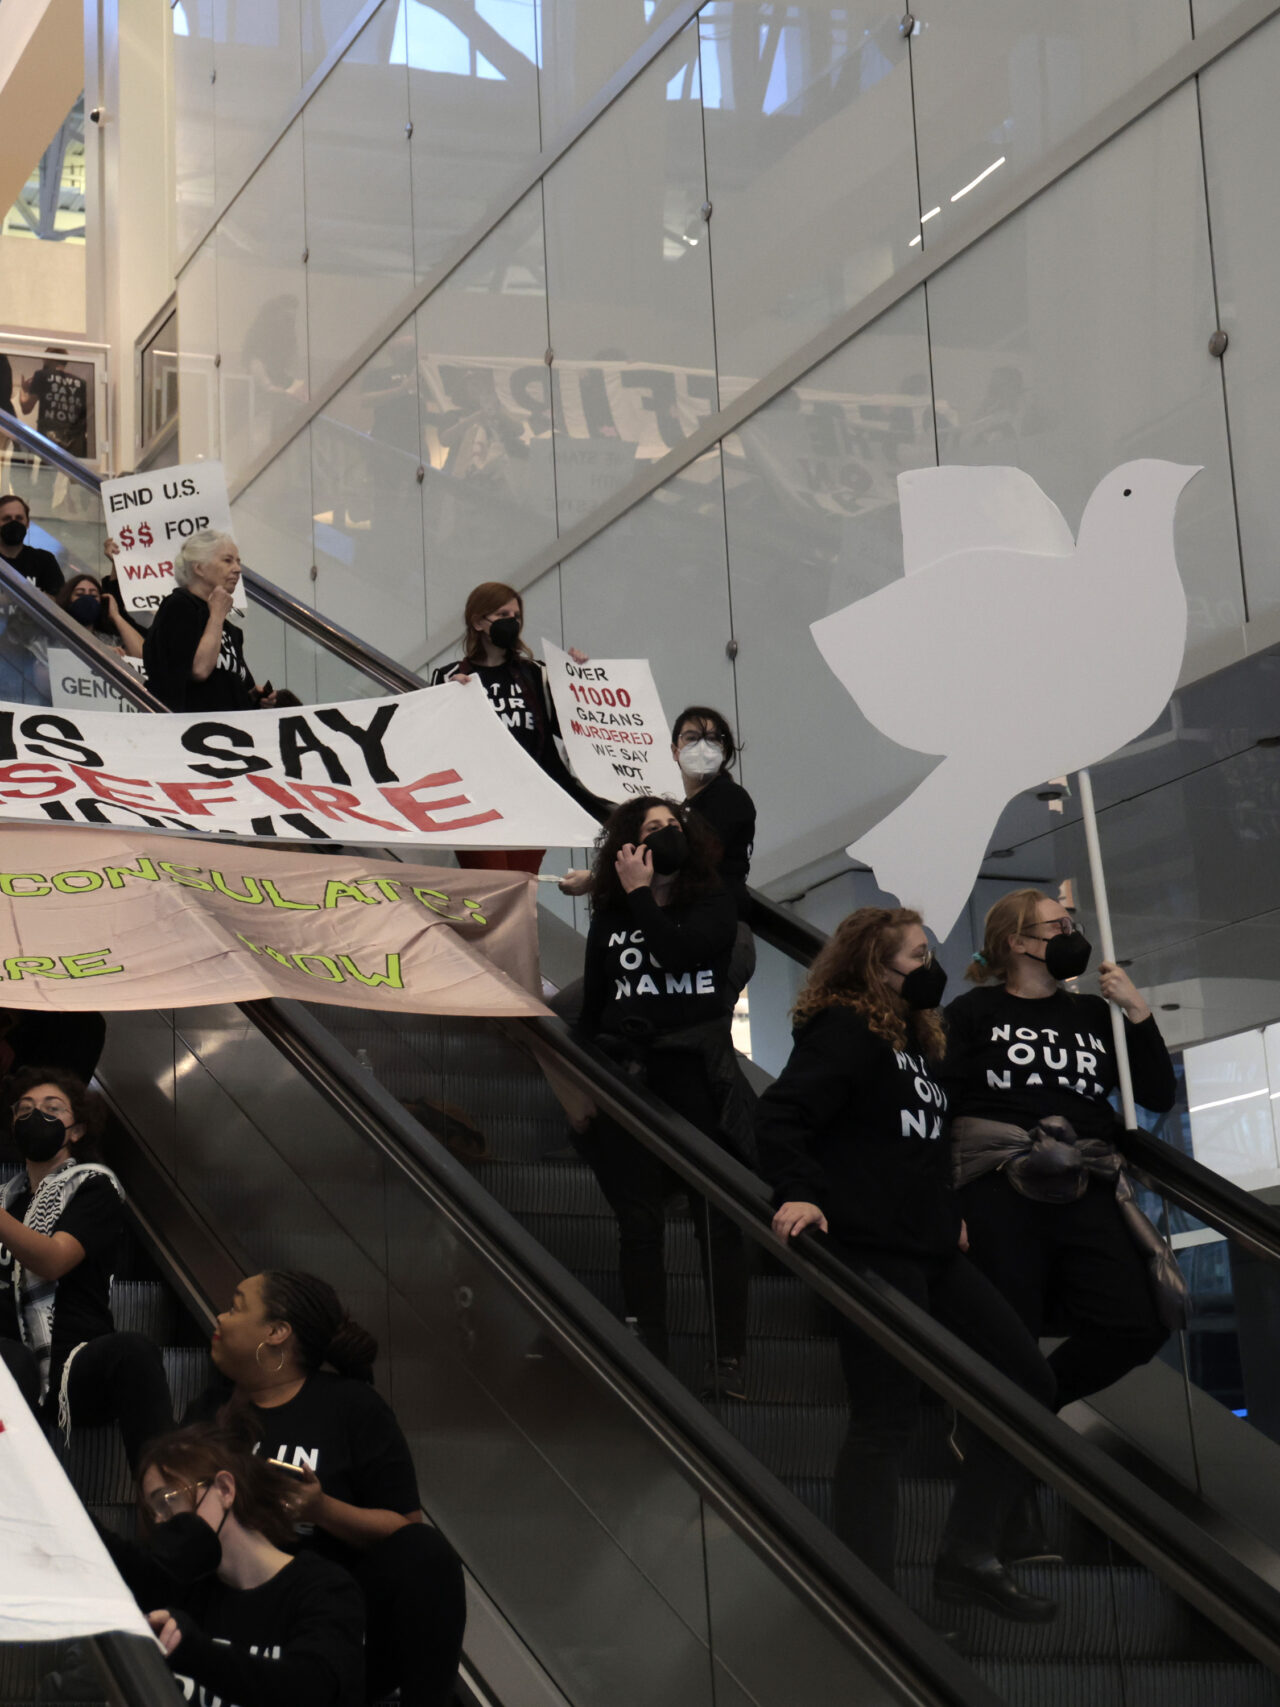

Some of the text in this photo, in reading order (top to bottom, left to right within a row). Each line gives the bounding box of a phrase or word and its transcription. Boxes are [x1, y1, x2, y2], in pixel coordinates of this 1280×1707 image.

[109, 478, 200, 513] END U.S.
[119, 515, 210, 551] $$ FOR
[123, 560, 175, 581] WAR
[132, 593, 168, 609] CR
[565, 661, 609, 681] OVER
[488, 697, 526, 712] UR
[569, 682, 631, 708] 11000
[500, 711, 535, 730] ME
[576, 706, 644, 726] GAZANS
[181, 703, 400, 787] SAY
[570, 719, 654, 746] MURDERED
[592, 742, 649, 763] WE SAY
[612, 762, 644, 781] NOT
[608, 929, 645, 948] NO
[614, 969, 716, 1001] NAME
[990, 1023, 1107, 1055] NOT IN
[1006, 1042, 1097, 1077] OUR
[900, 1109, 942, 1140] NA
[275, 1444, 319, 1472] IN
